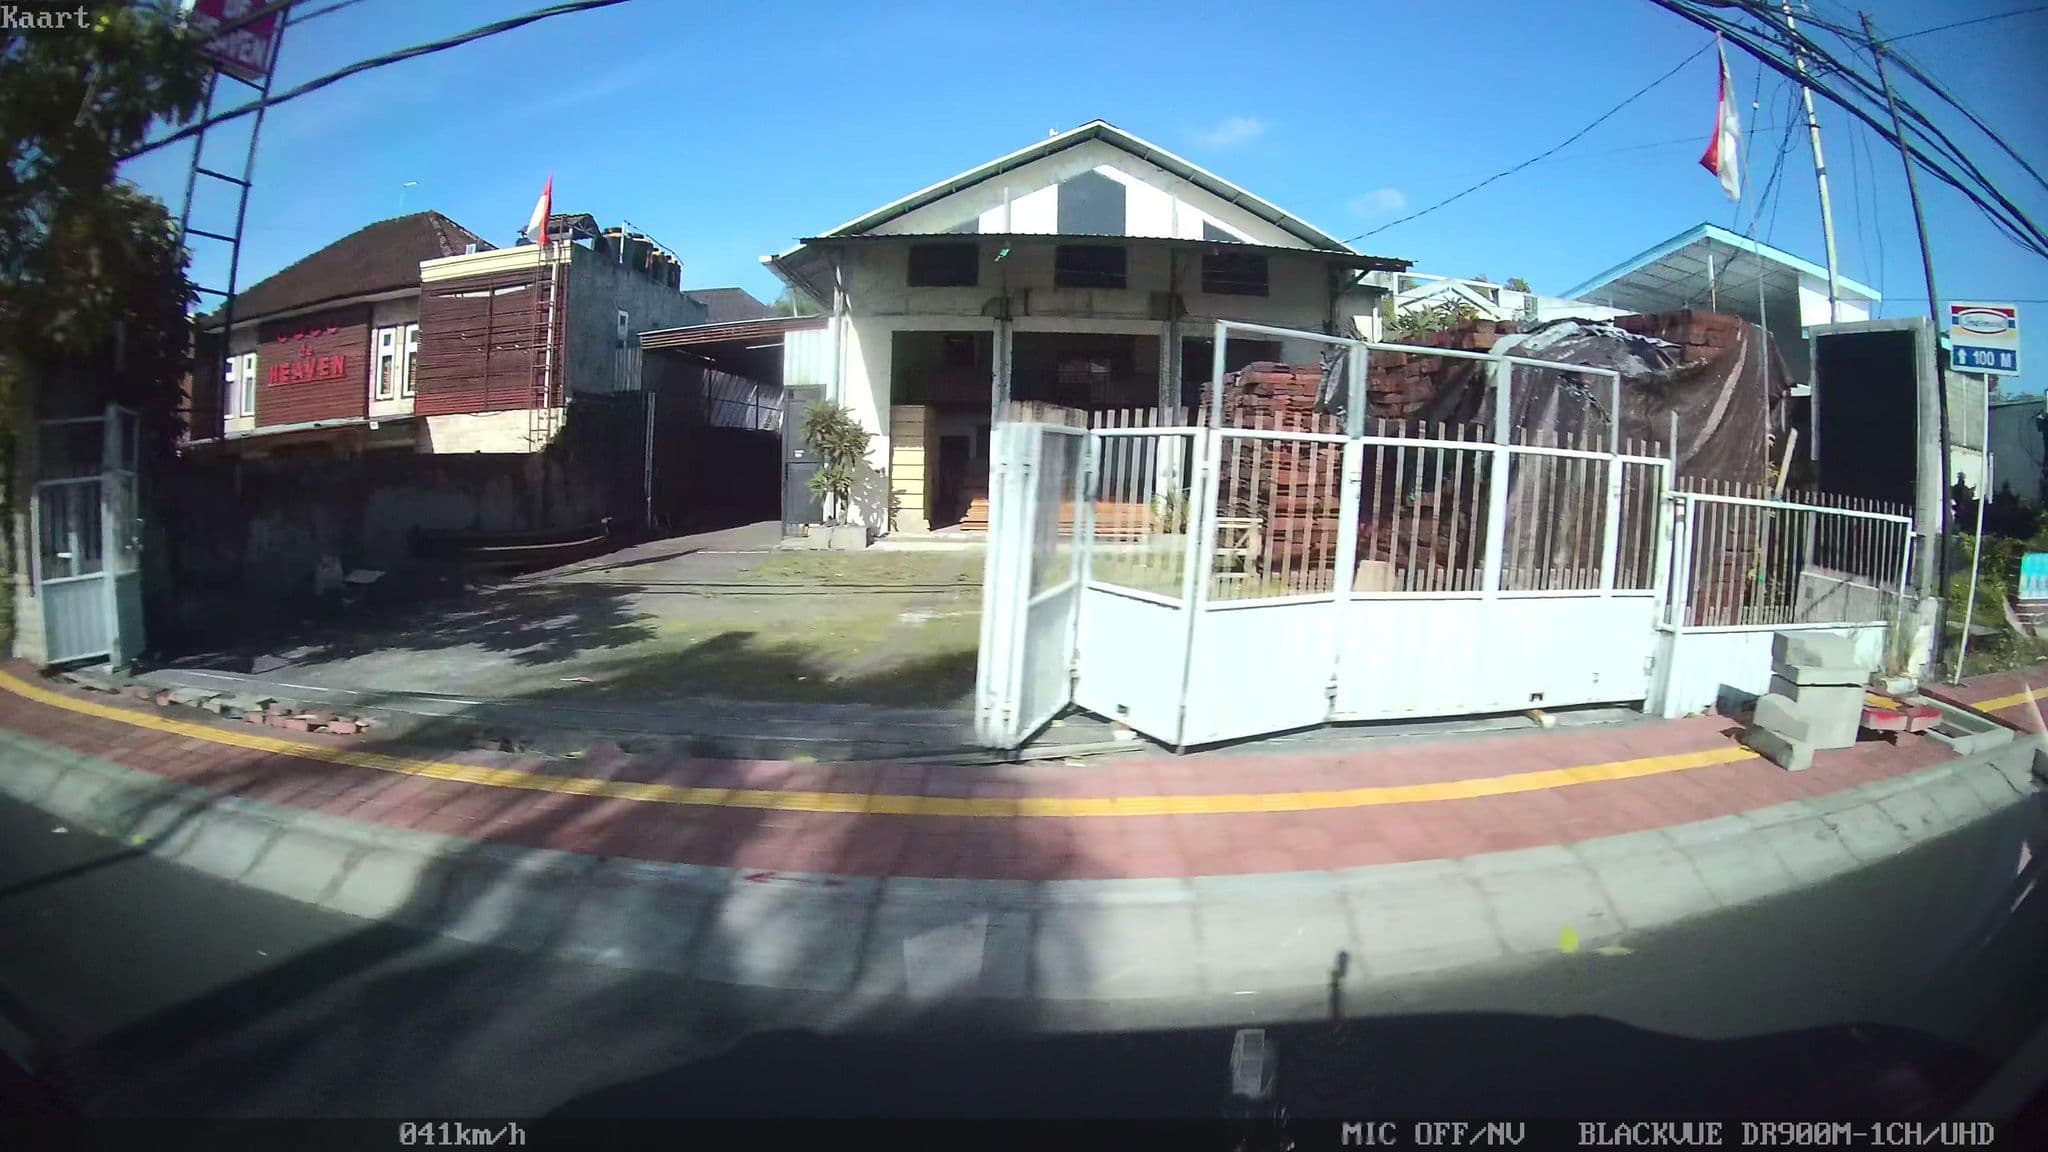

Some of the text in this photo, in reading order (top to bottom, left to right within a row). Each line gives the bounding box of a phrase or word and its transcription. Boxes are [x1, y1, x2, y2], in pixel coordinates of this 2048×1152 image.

[267, 355, 345, 386] HEAVEN
[1973, 350, 2012, 368] 100 M
